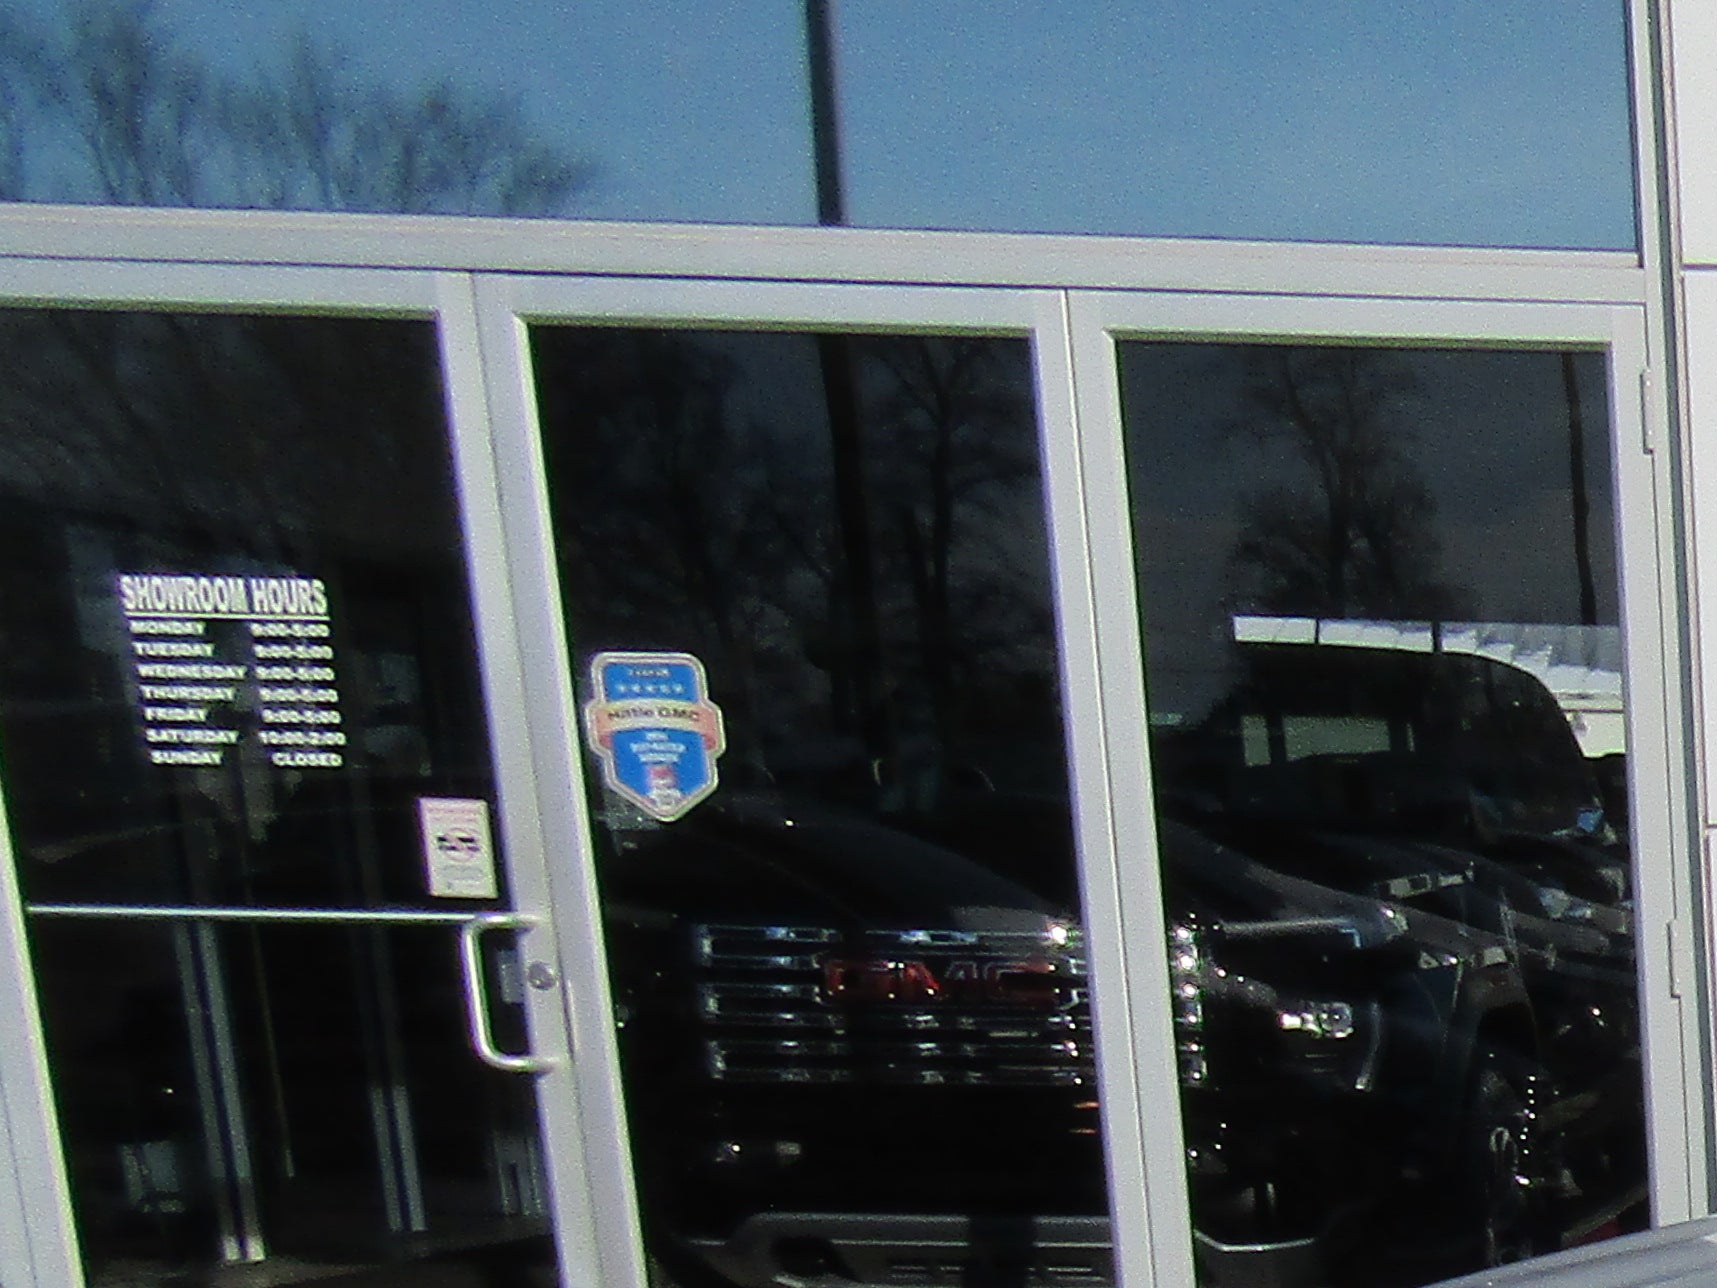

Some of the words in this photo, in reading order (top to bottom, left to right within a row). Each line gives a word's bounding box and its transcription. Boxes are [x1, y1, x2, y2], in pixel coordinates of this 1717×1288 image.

[119, 575, 249, 613] SHOWROOM
[250, 577, 328, 615] HOURS
[129, 620, 206, 636] MONDAY
[131, 641, 214, 658] TUESDAY
[136, 663, 247, 680] WEDNESDAY
[139, 685, 237, 702] THURSDAY
[143, 706, 208, 722] FRIDAY
[146, 728, 239, 744] SATURDAY
[151, 750, 223, 766] SUNDAY
[271, 752, 343, 767] CLOSED
